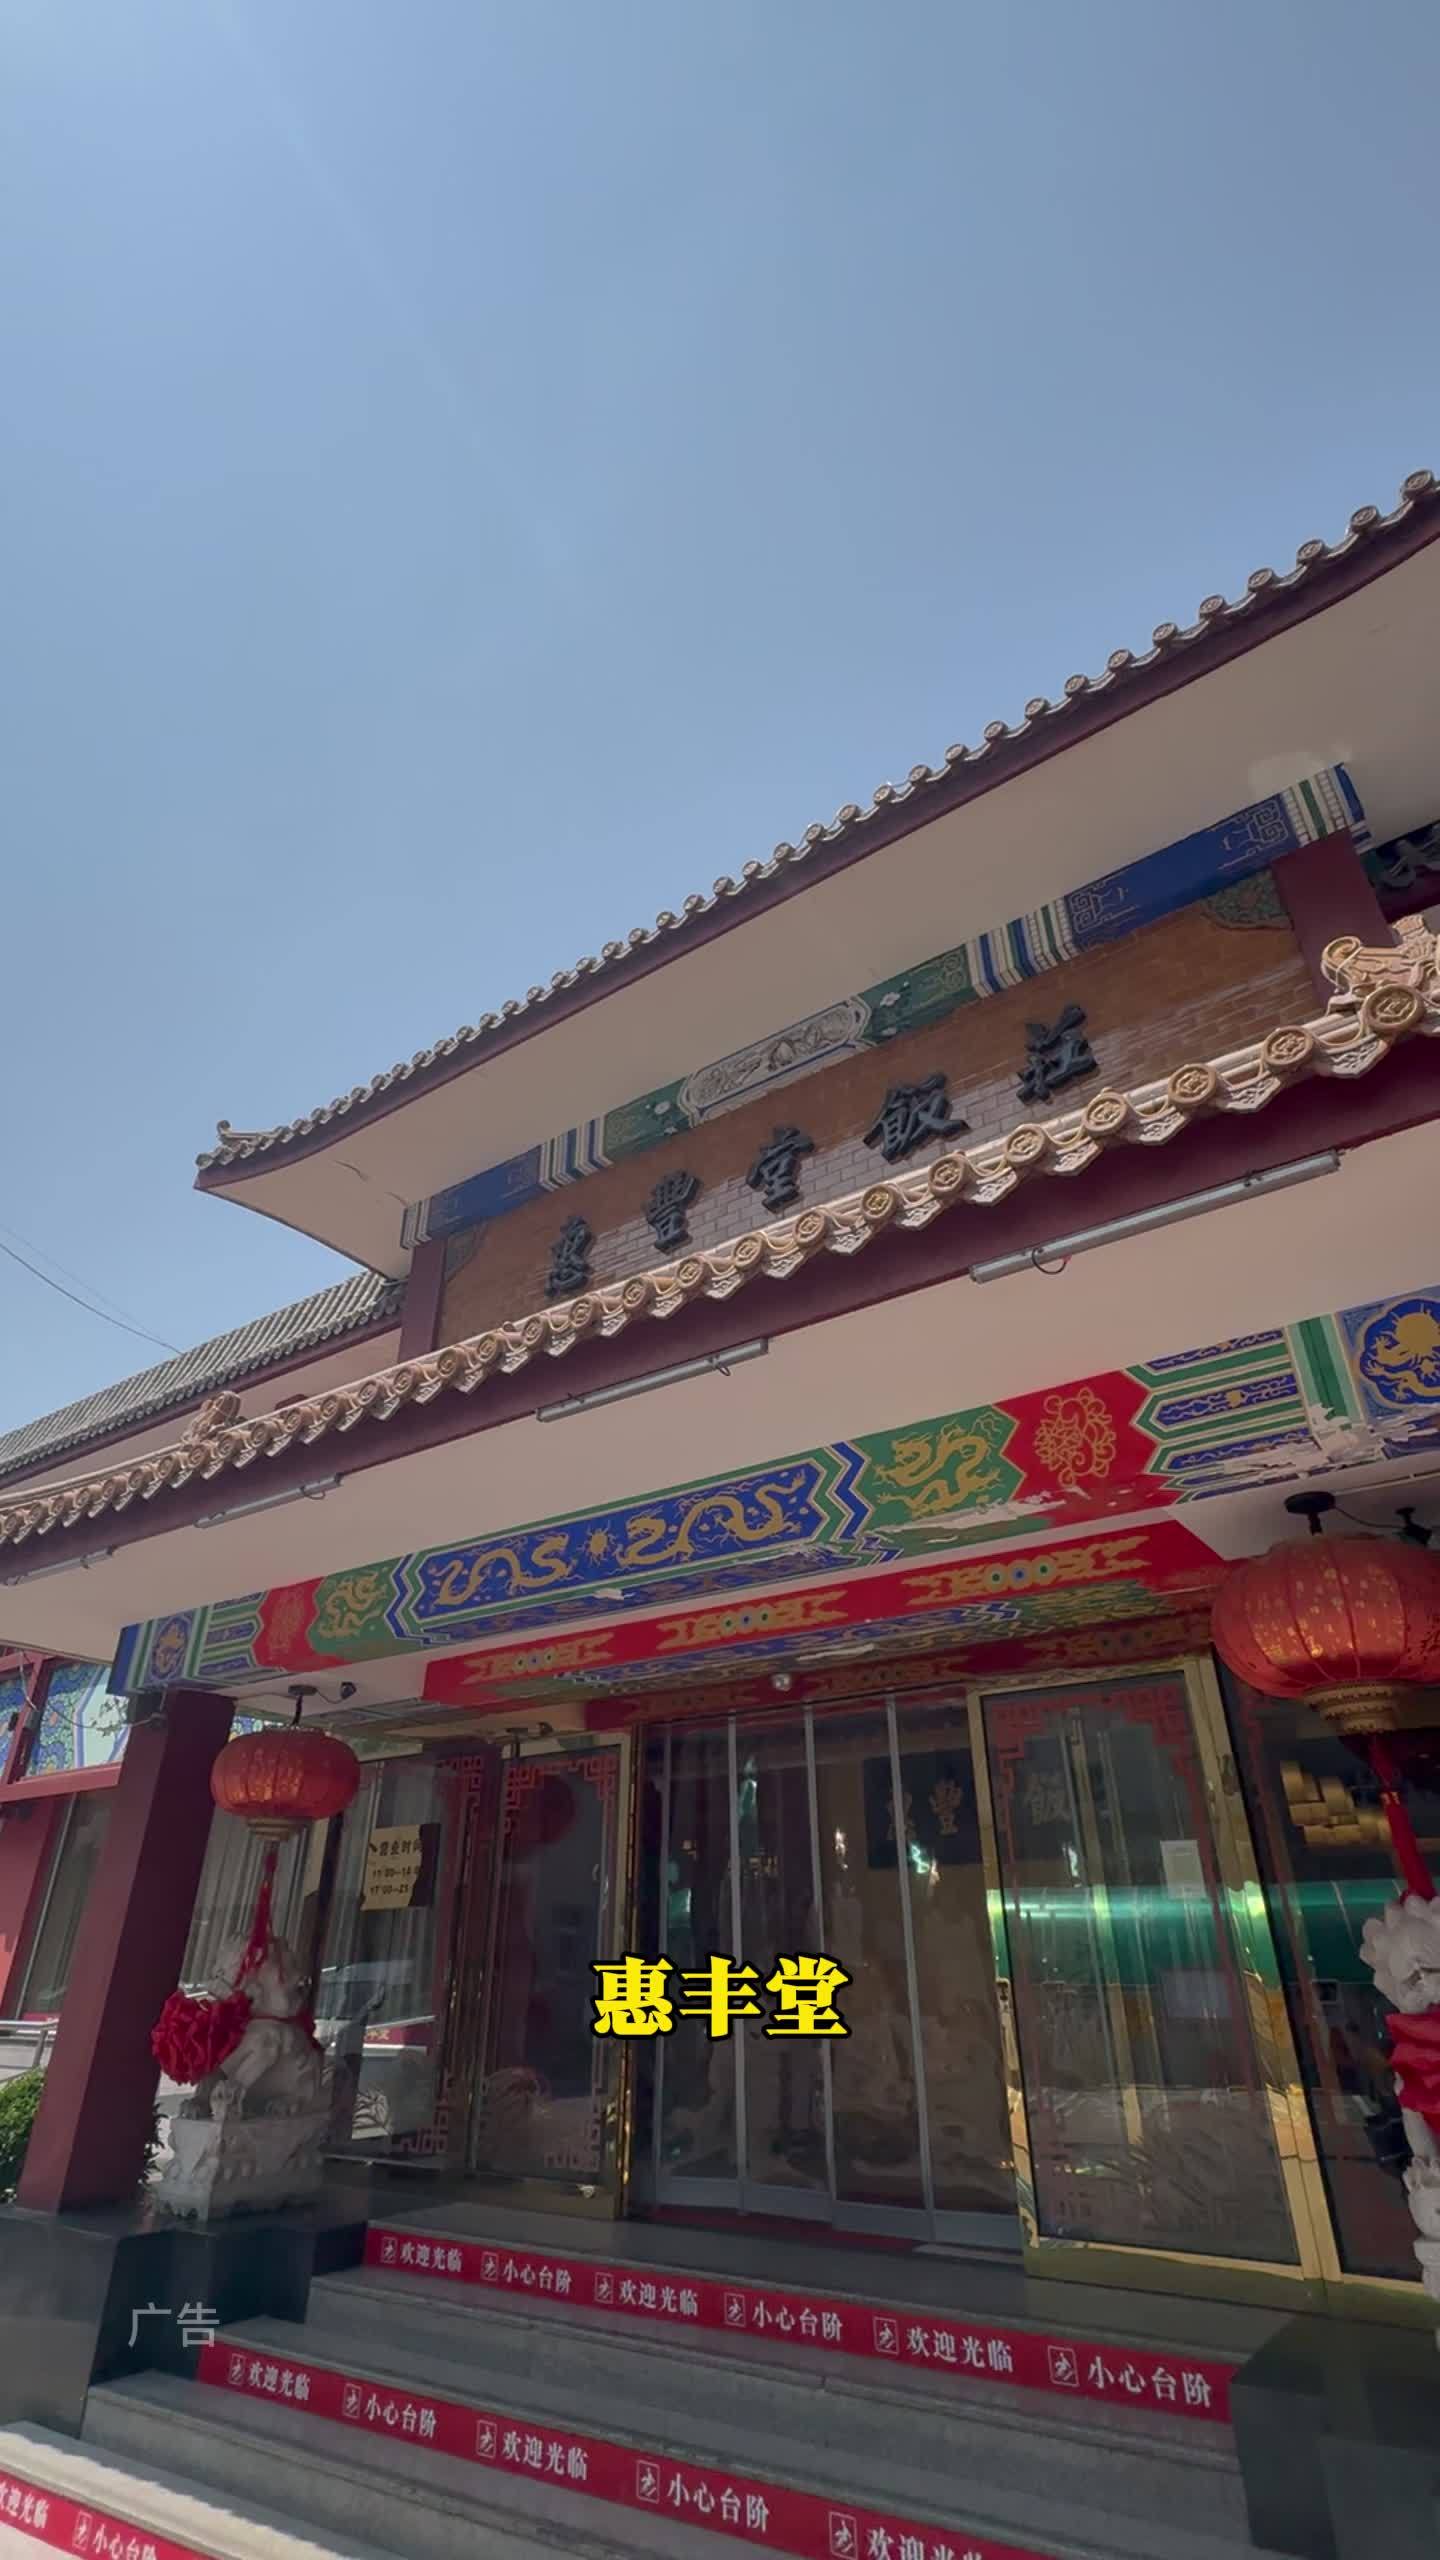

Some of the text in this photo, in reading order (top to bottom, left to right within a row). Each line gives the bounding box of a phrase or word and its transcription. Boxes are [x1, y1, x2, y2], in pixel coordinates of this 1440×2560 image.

[399, 2240, 463, 2273] 欢迎光临
[502, 2258, 573, 2295] 小心台阶
[618, 2278, 700, 2317] 欢迎光临
[752, 2305, 844, 2343] 小心台阶
[905, 2326, 1014, 2374] 欢迎光临
[248, 2360, 311, 2402] 欢迎光临
[1086, 2354, 1212, 2410] 小心台阶
[364, 2394, 437, 2439] 小心台阶
[501, 2429, 588, 2481] 欢迎光临
[667, 2471, 770, 2534] 小心台阶
